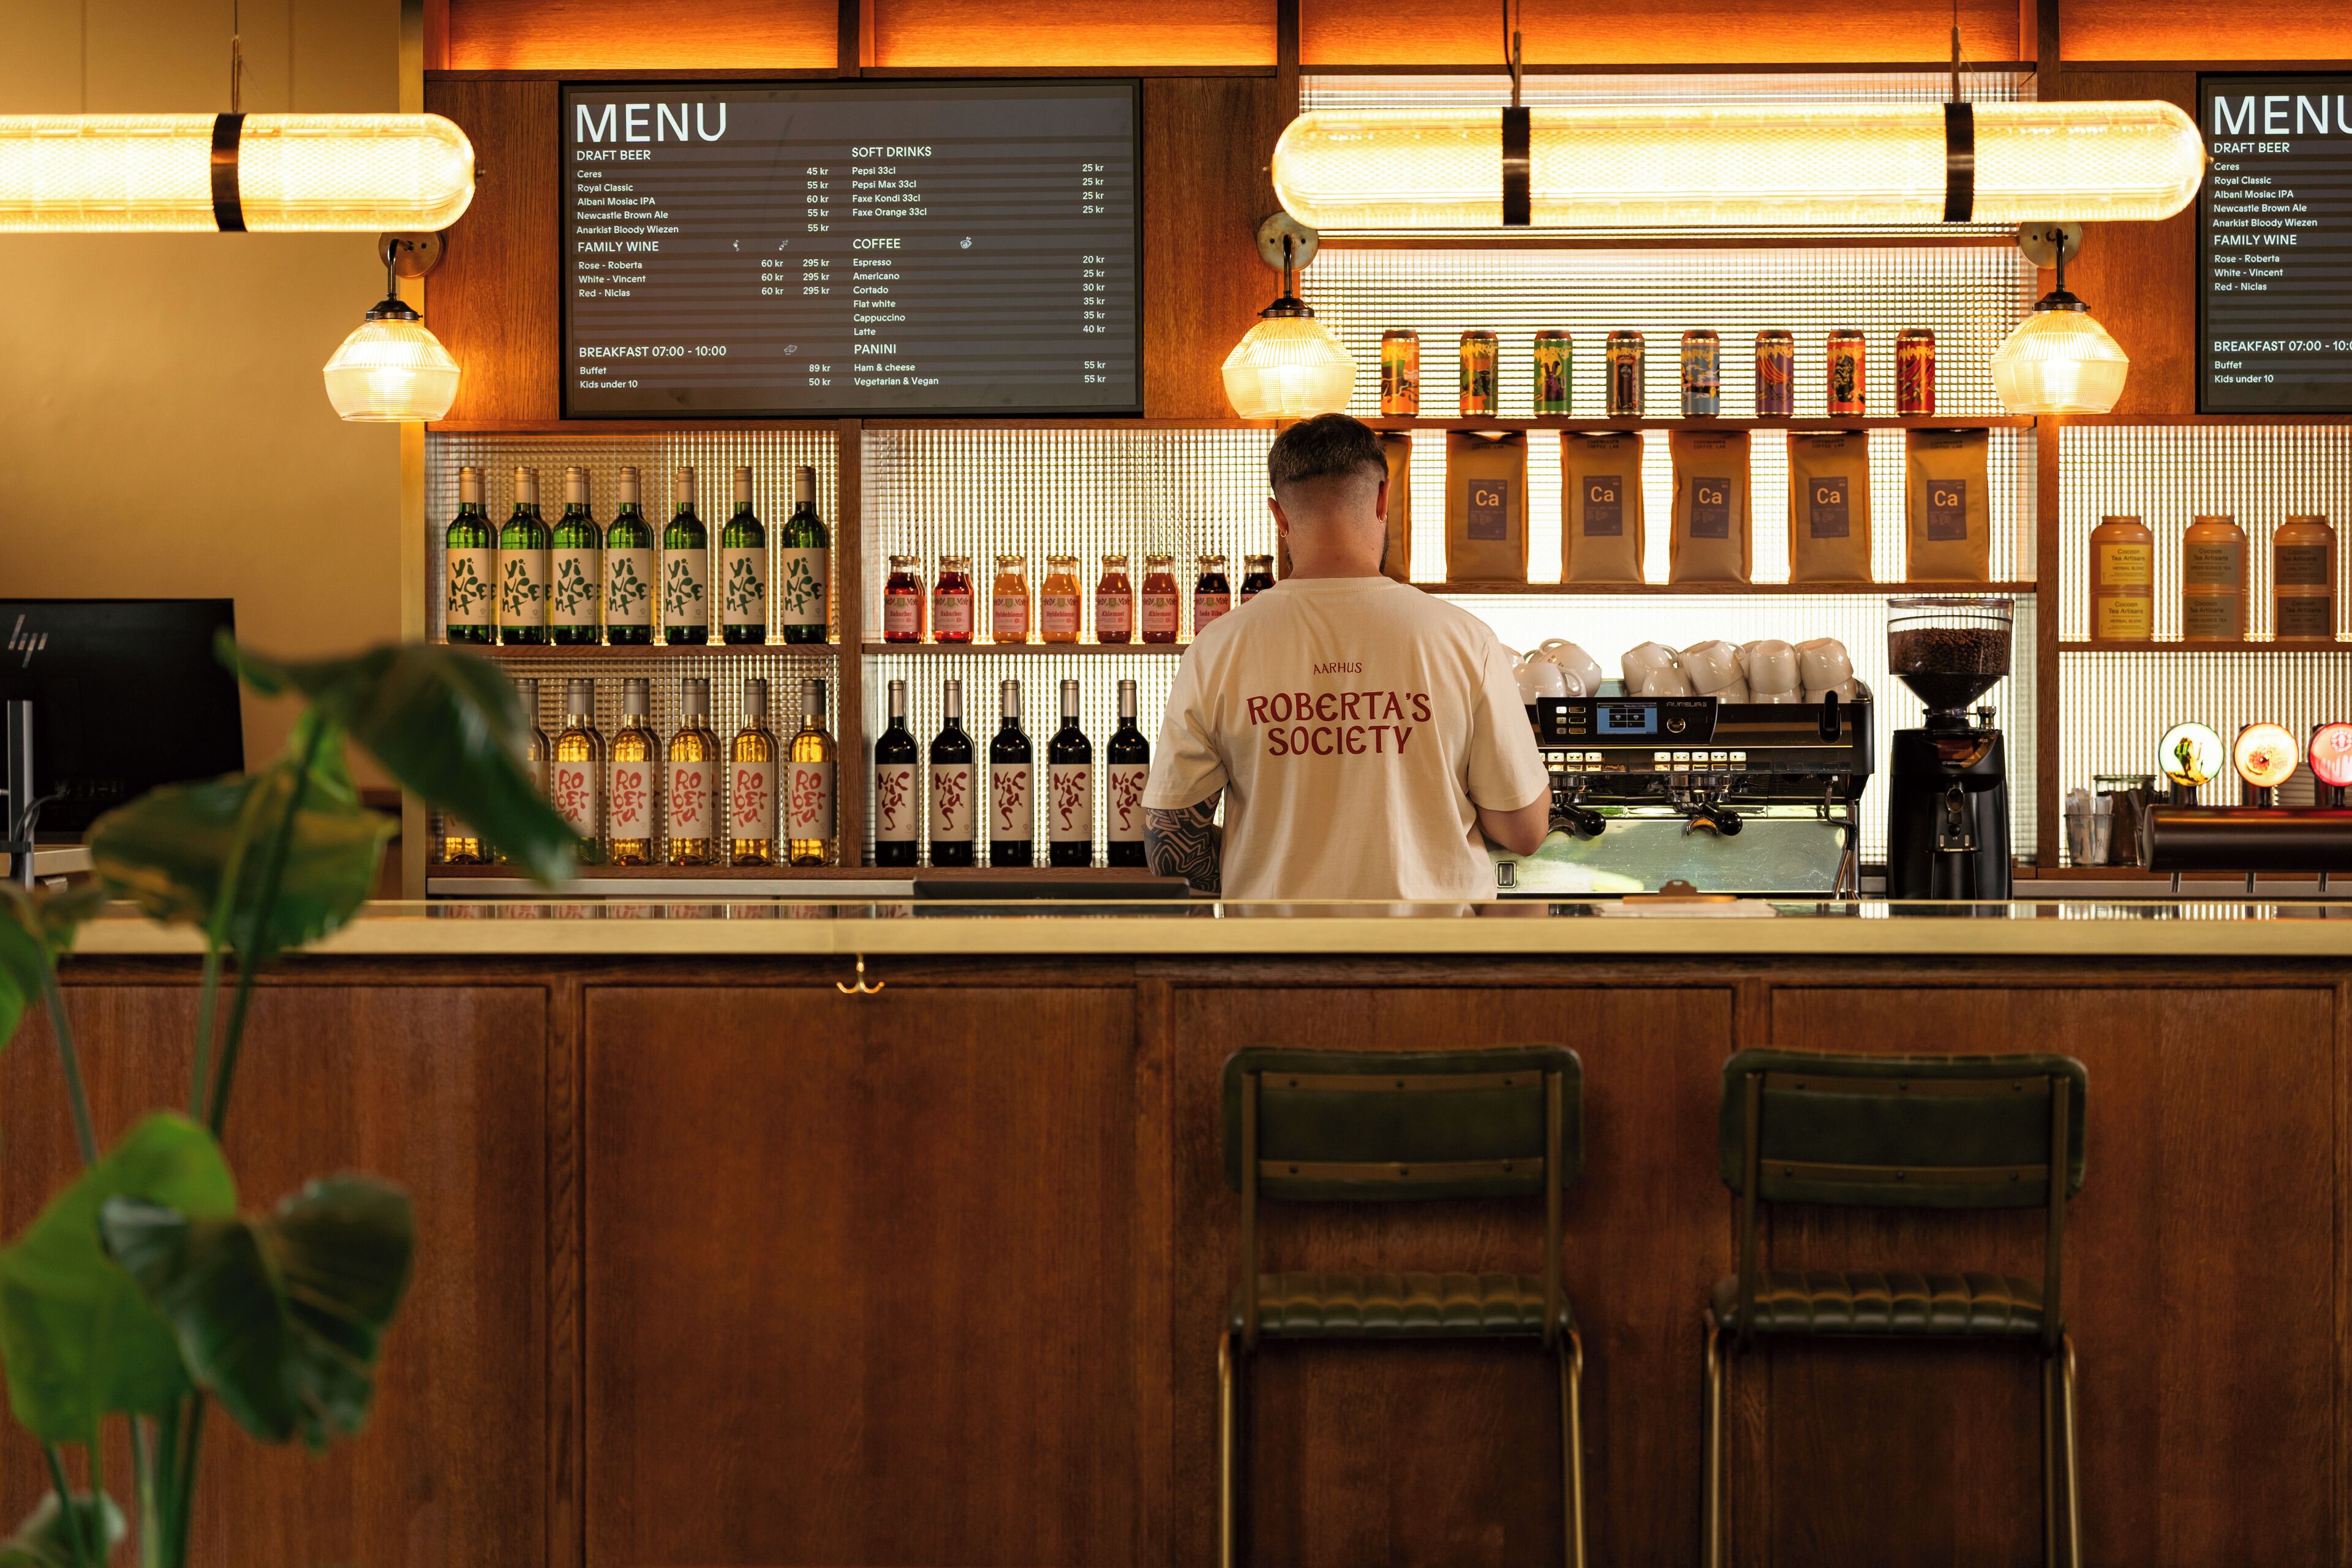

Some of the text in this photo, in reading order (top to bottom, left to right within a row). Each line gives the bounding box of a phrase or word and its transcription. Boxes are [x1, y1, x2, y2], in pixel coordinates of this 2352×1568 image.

[576, 102, 726, 143] MENU
[851, 146, 932, 157] SOFT DRINKS
[2214, 142, 2290, 153] DRAFT BEER
[577, 149, 651, 160] DRAFT BEER
[852, 166, 896, 176] Pepsi 33cl
[1082, 164, 1093, 172] 25
[2214, 162, 2240, 171] Ceres
[577, 170, 602, 178] Ceres
[807, 181, 829, 189] 55 kr
[852, 179, 916, 190] Pepsi Max 33cl
[2214, 176, 2272, 186] Royal Classic
[578, 183, 633, 194] Royal Classic
[806, 195, 818, 203] 60
[852, 194, 921, 203] Faxe Kondi 33cl
[1082, 191, 1104, 200] 25 kr
[607, 197, 638, 206] Mosiac
[640, 197, 656, 205] IPA
[807, 208, 829, 217] 55 kr
[875, 208, 907, 217] Orange
[909, 207, 927, 216] 33cl
[1082, 205, 1093, 214] 25
[624, 211, 652, 219] Brown
[654, 210, 669, 219] Ale
[614, 225, 645, 235] Bloody
[646, 225, 679, 233] Wiezen
[807, 224, 819, 232] 55
[853, 238, 901, 249] COFFEE
[2214, 234, 2297, 246] FAMILY WINE
[578, 241, 659, 252] FAMILY WINE
[608, 261, 643, 270] Roberta
[761, 259, 772, 268] 60
[802, 258, 819, 267] 295
[853, 258, 892, 268] Espresso
[803, 273, 819, 281] 295
[1083, 269, 1095, 277] 25
[578, 275, 605, 284] White
[761, 287, 773, 295] 60
[803, 286, 830, 295] 295 kr
[853, 285, 889, 294] Cortado
[1083, 283, 1095, 292] 30
[605, 288, 630, 297] Niclas
[853, 300, 870, 308] Flat
[853, 314, 906, 323] Cappuccino
[1084, 311, 1106, 319] 35 kr
[1082, 325, 1095, 333] 40
[854, 344, 896, 354] PANINI
[2214, 340, 2322, 352] BREAKFAST 07:00
[579, 345, 726, 358] BREAKFAST 07:00 10:00
[809, 364, 820, 372] 89
[854, 363, 874, 372] Ham
[1084, 361, 1095, 369] 55
[2214, 361, 2242, 369] Buffet
[580, 366, 607, 375] Buffet
[809, 377, 820, 386] 50
[854, 377, 939, 387] Vegetarian & Vegan
[1084, 374, 1095, 383] 55
[2214, 374, 2274, 383] Kids under 10
[600, 380, 627, 388] under
[628, 380, 638, 388] 10
[1476, 489, 1499, 507] Ca
[1590, 486, 1615, 502] Ca
[1698, 488, 1722, 505] Ca
[1817, 488, 1841, 504] Ca
[1934, 490, 1958, 507] Ca
[8, 614, 48, 668] hp
[1313, 662, 1362, 674] AARHUS
[1246, 691, 1431, 725] ROBERTA'S
[1268, 726, 1413, 756] SOCIETY
